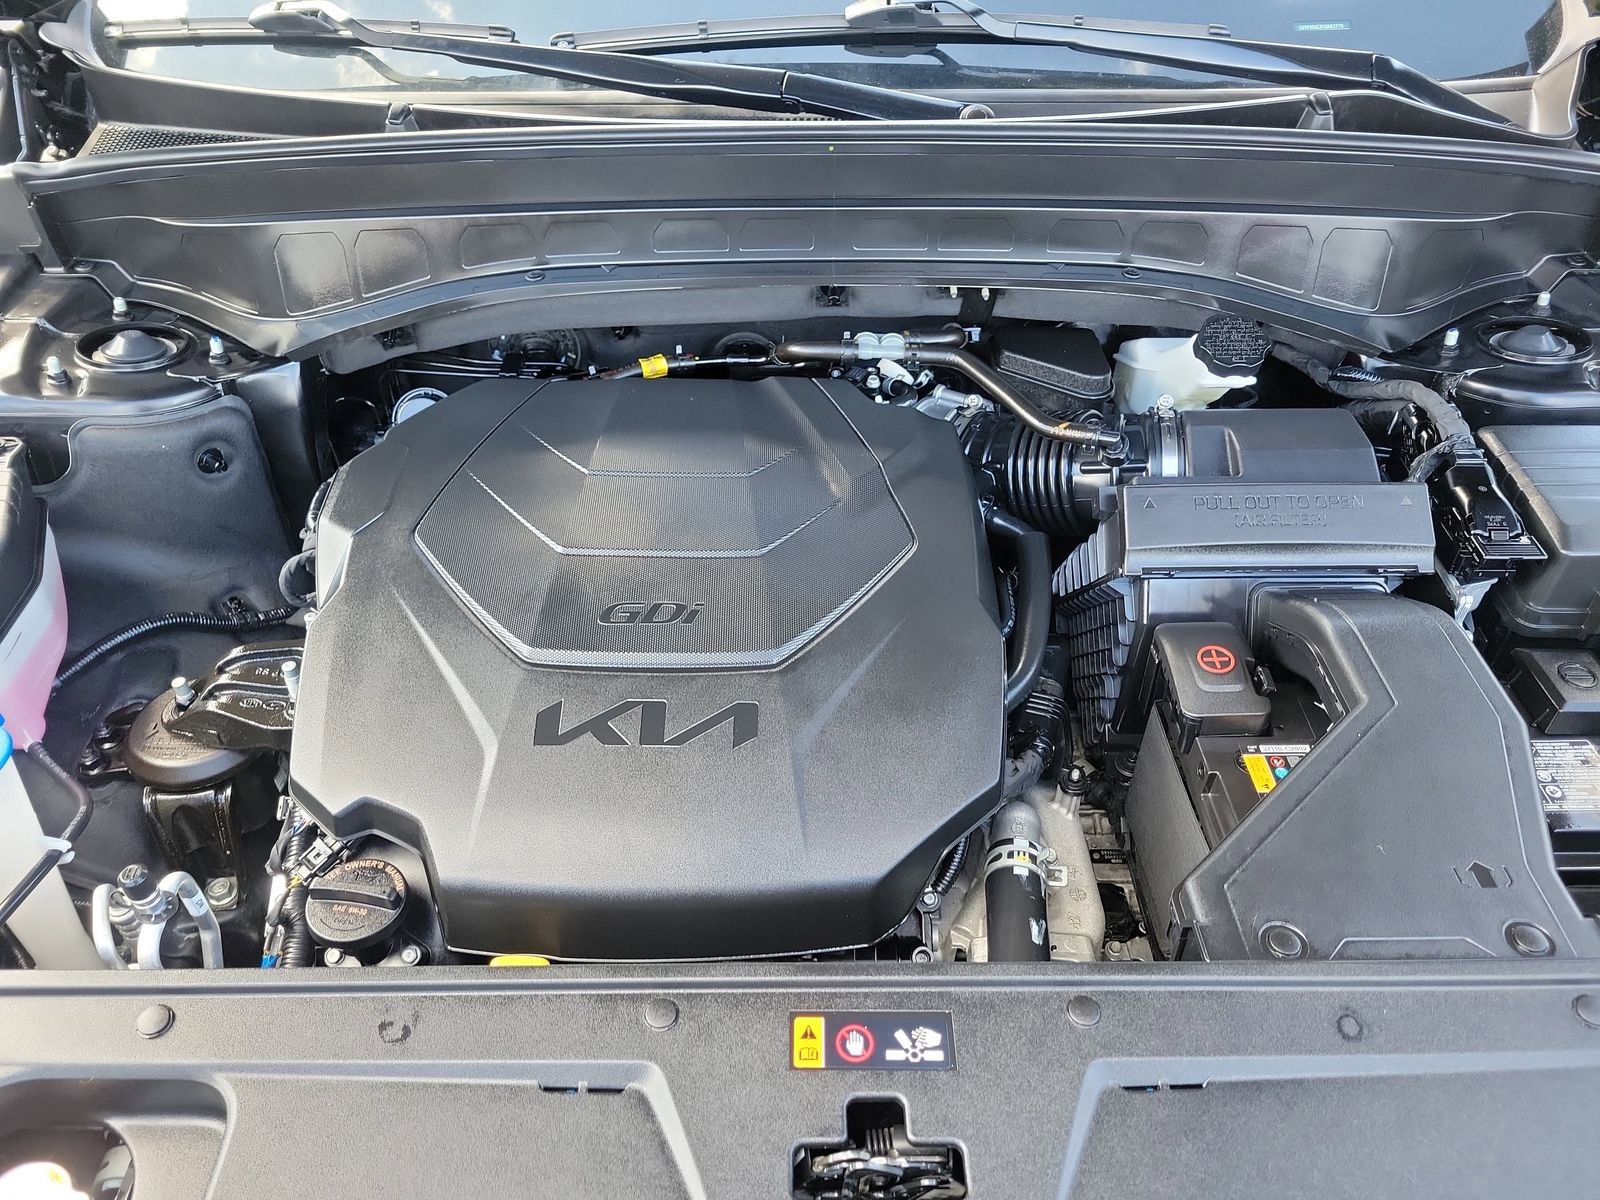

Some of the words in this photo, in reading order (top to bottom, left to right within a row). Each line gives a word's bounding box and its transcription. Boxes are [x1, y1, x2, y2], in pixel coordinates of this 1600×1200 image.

[1192, 494, 1241, 511] PULL
[1244, 494, 1281, 510] OUT
[1285, 494, 1310, 510] TO
[1315, 494, 1364, 510] OPEN
[598, 601, 705, 626] GDi
[533, 698, 760, 750] KIA
[344, 859, 384, 871] OWNER'S
[385, 866, 404, 891] MANUAL
[332, 903, 347, 913] SAE
